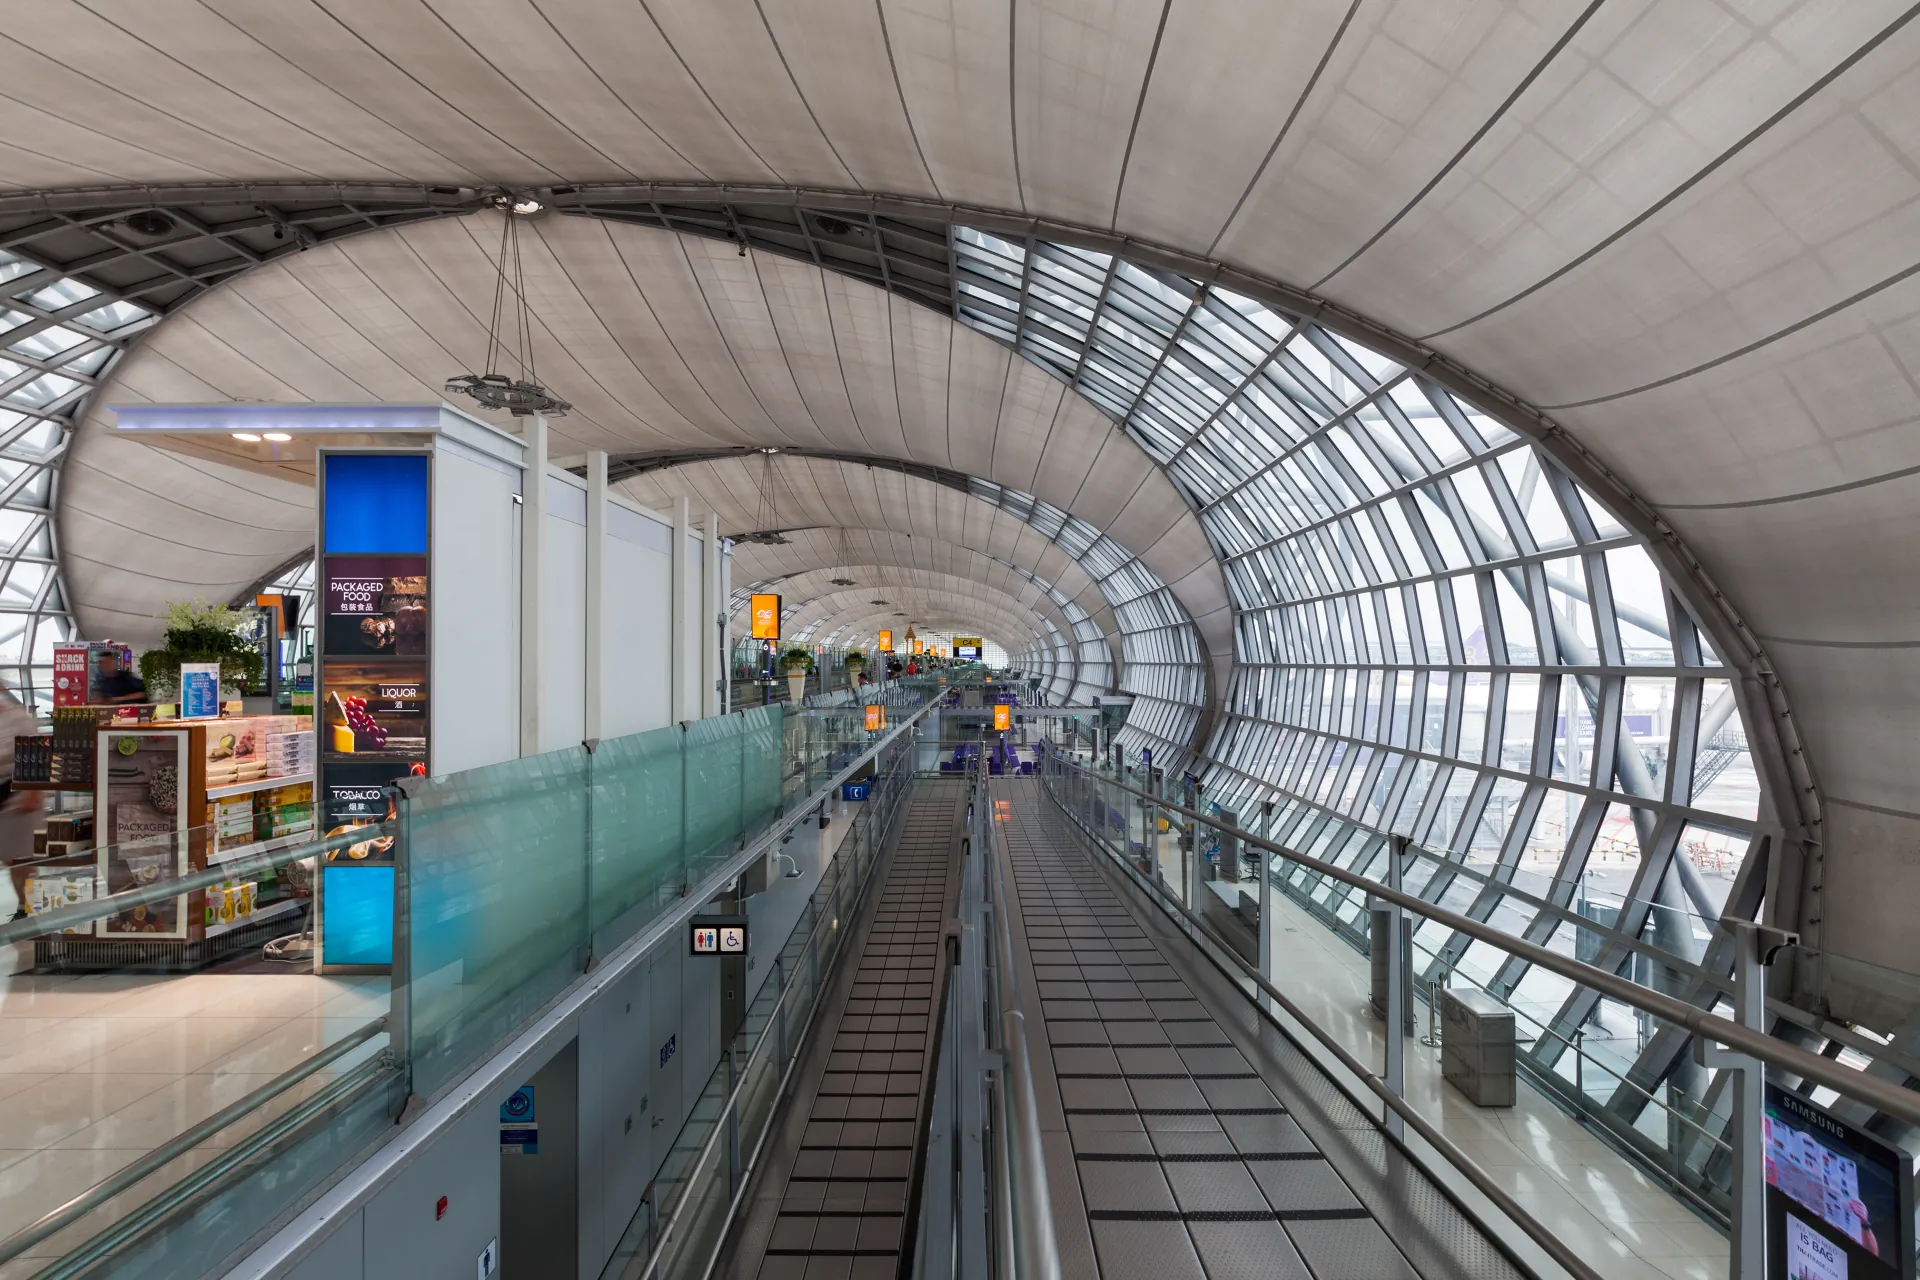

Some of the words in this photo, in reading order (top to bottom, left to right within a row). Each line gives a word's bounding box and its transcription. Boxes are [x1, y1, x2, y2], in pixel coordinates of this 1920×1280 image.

[331, 582, 384, 592] PACKAGED
[343, 592, 371, 602] FOOD
[340, 602, 374, 612] 包装食品
[56, 654, 84, 664] SNACK
[381, 688, 417, 699] LIQUOR
[394, 700, 403, 709] 酒
[332, 790, 381, 800] TOBACCO
[348, 802, 366, 811] 烟草
[1784, 1096, 1844, 1138] SAMSUNG
[1800, 1232, 1810, 1246] IS
[1812, 1240, 1834, 1264] BAG
